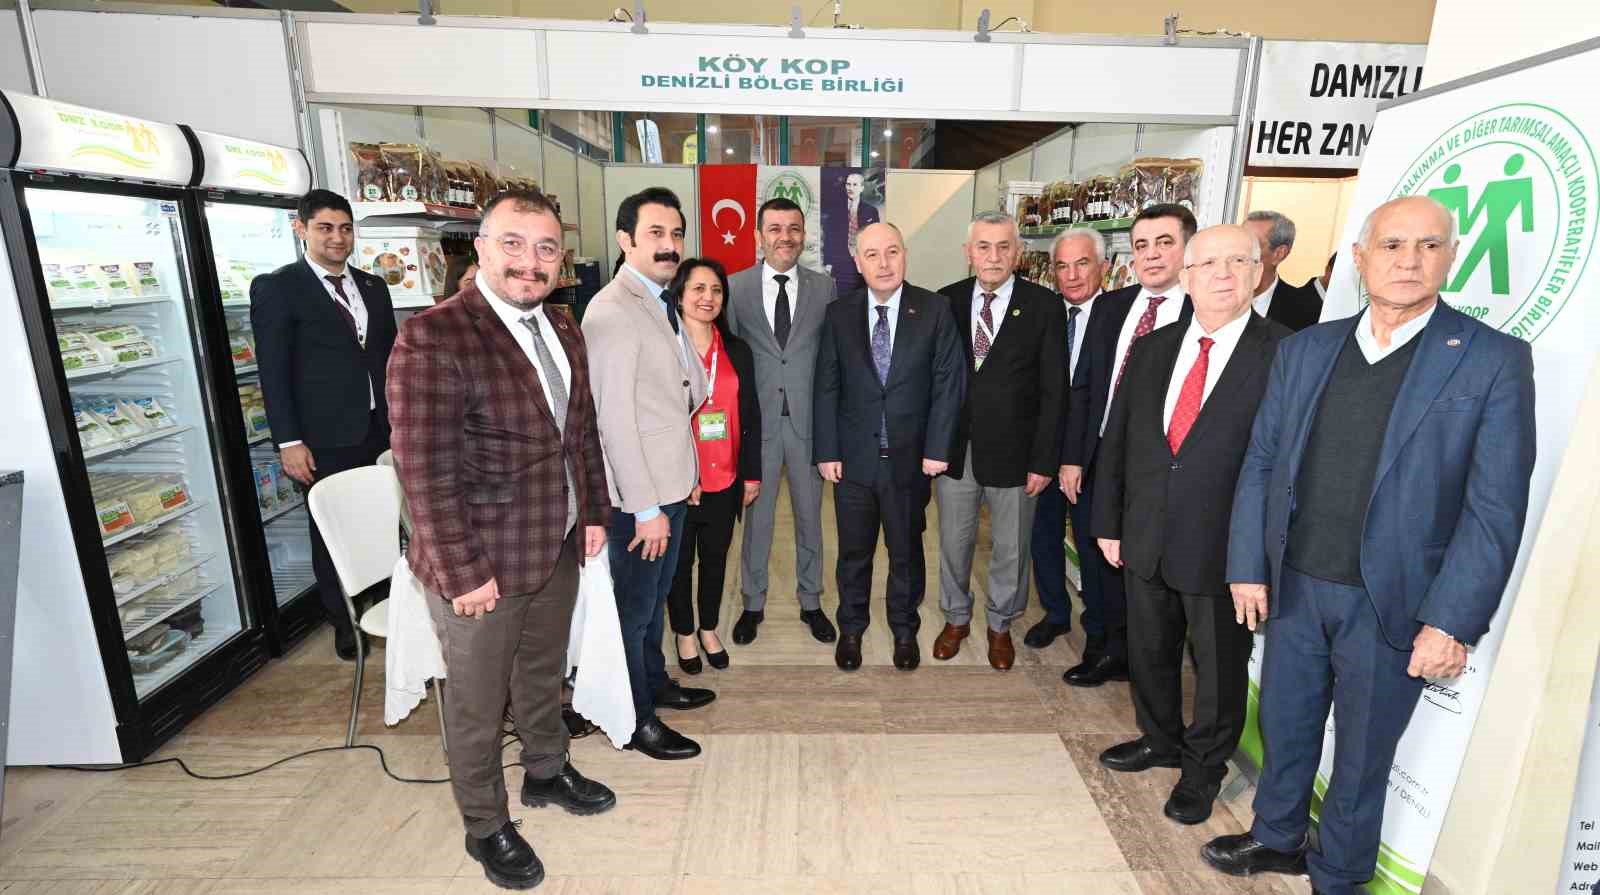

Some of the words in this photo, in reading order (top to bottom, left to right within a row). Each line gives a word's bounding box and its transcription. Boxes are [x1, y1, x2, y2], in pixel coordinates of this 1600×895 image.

[698, 53, 769, 74] KÖY
[780, 58, 851, 75] KOP
[640, 73, 731, 90] DENİZLİ
[738, 75, 815, 92] BÖLGE
[821, 77, 905, 94] BİRLİĞİ
[1309, 62, 1424, 100] DAMIZLI
[1256, 120, 1312, 155] HER
[1319, 122, 1374, 157] ZAM
[1446, 133, 1462, 152] VE
[1463, 119, 1498, 144] DİĞER
[1544, 174, 1588, 295] KOOPERATİFLER
[1579, 820, 1595, 831] Tel
[1576, 840, 1600, 851] Mail
[1573, 861, 1598, 871] Web
